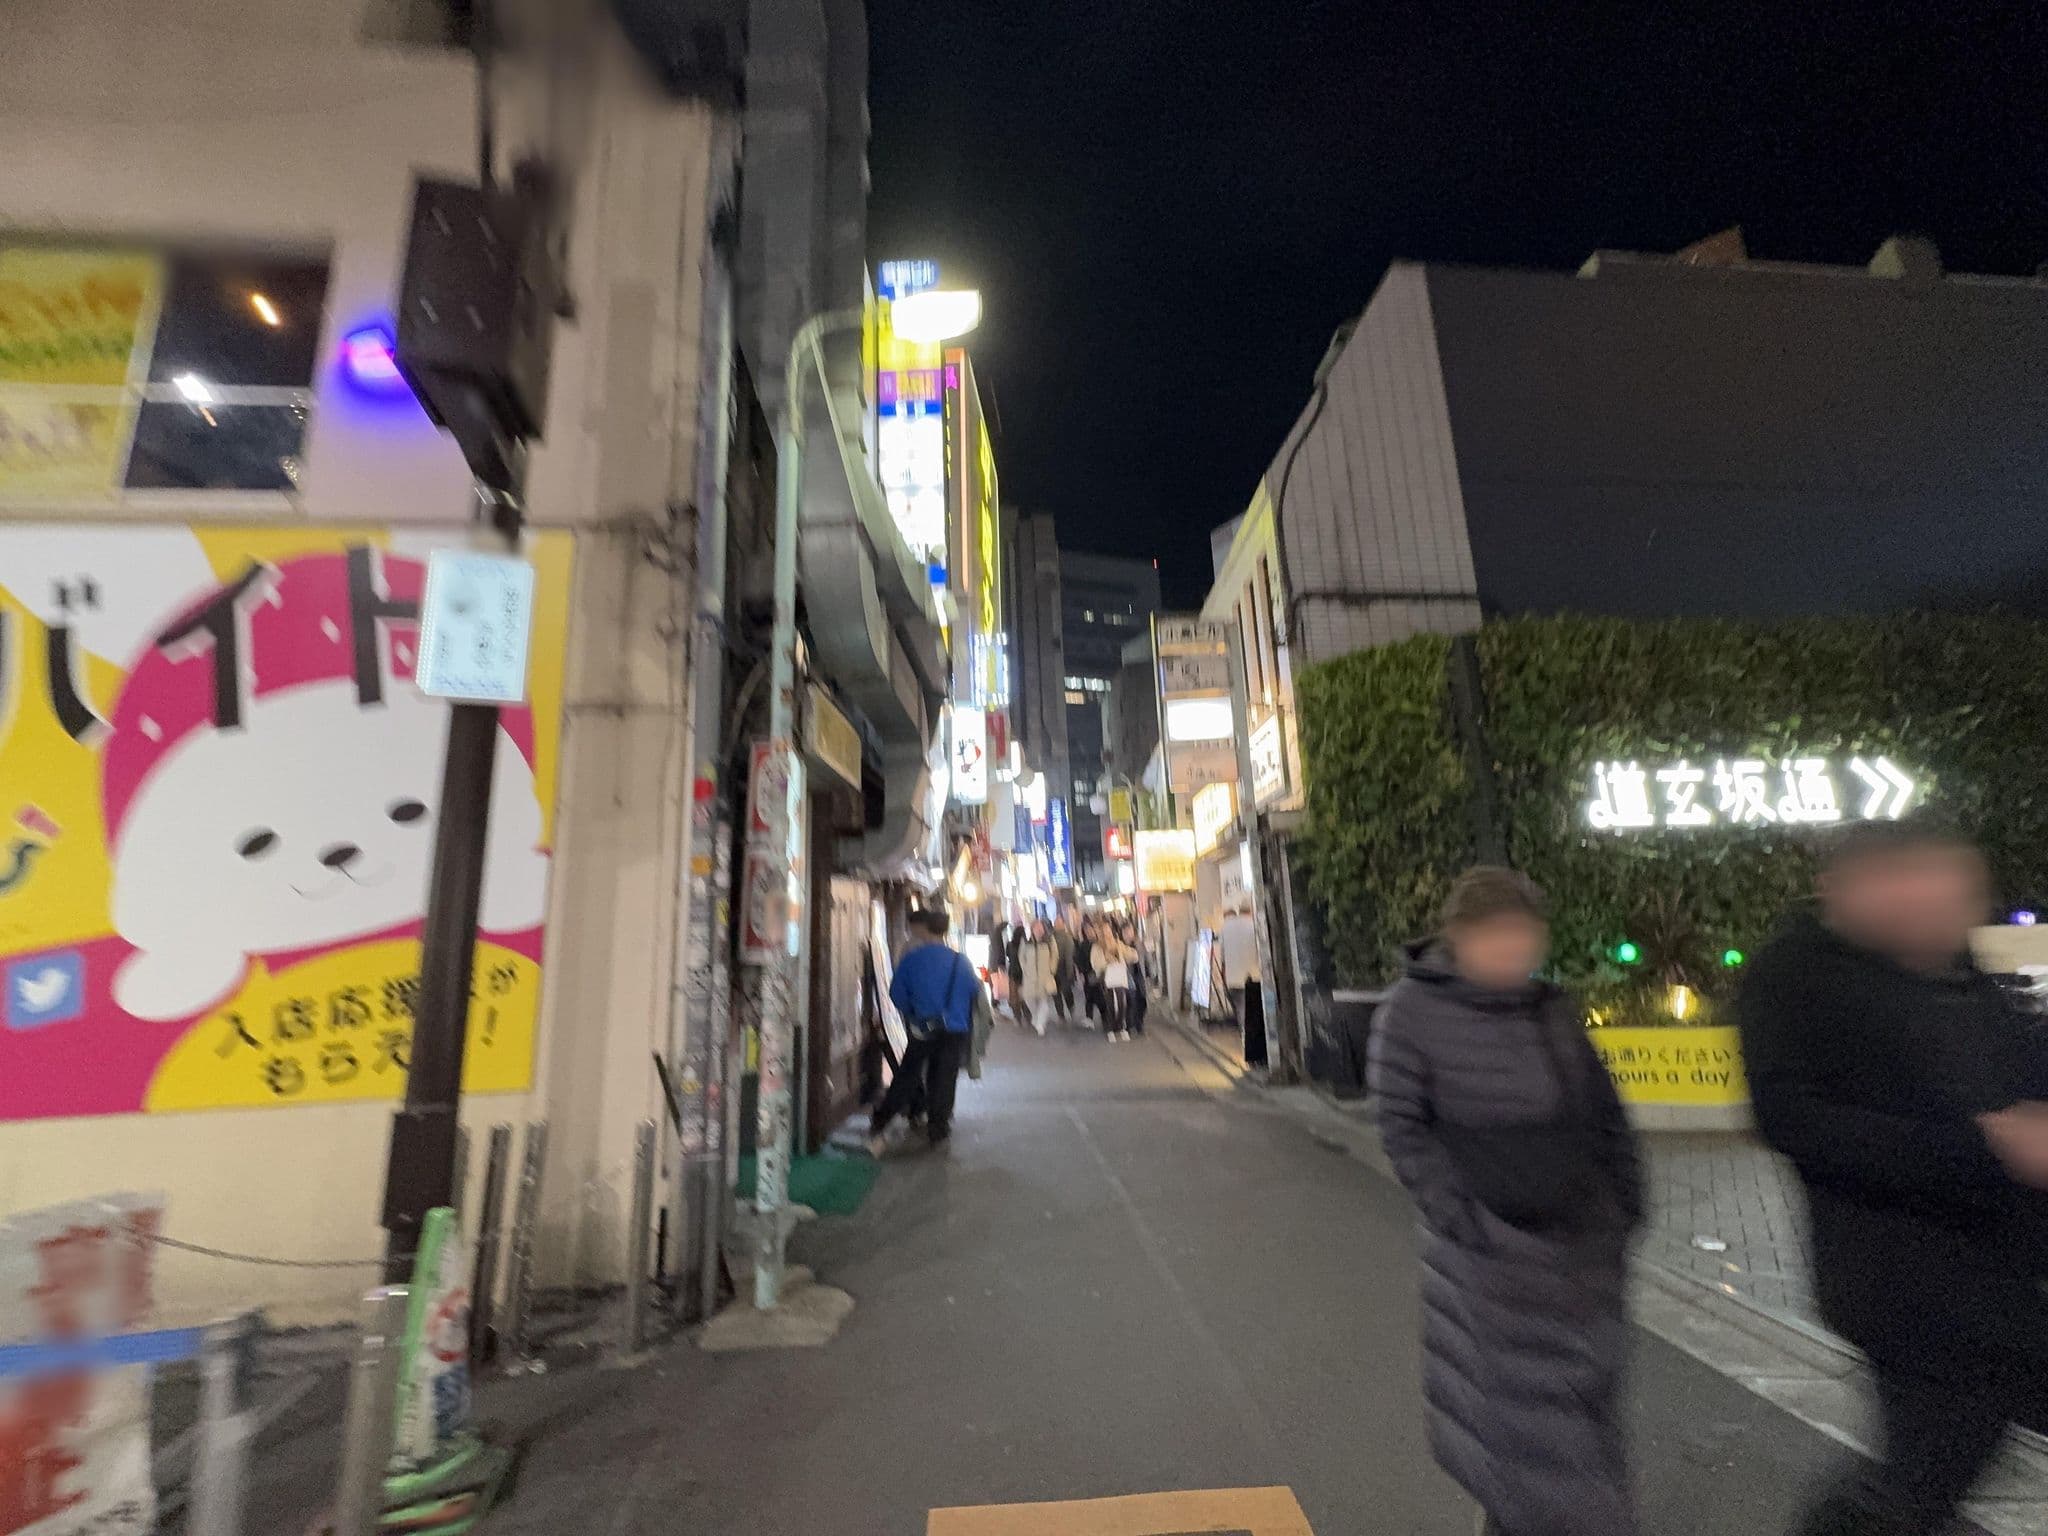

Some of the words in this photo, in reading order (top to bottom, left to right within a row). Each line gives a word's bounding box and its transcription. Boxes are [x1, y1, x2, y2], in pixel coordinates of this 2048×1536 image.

[1588, 758, 1842, 828] 道玄坂通
[1665, 1070, 1679, 1085] a
[1690, 1068, 1731, 1088] day
